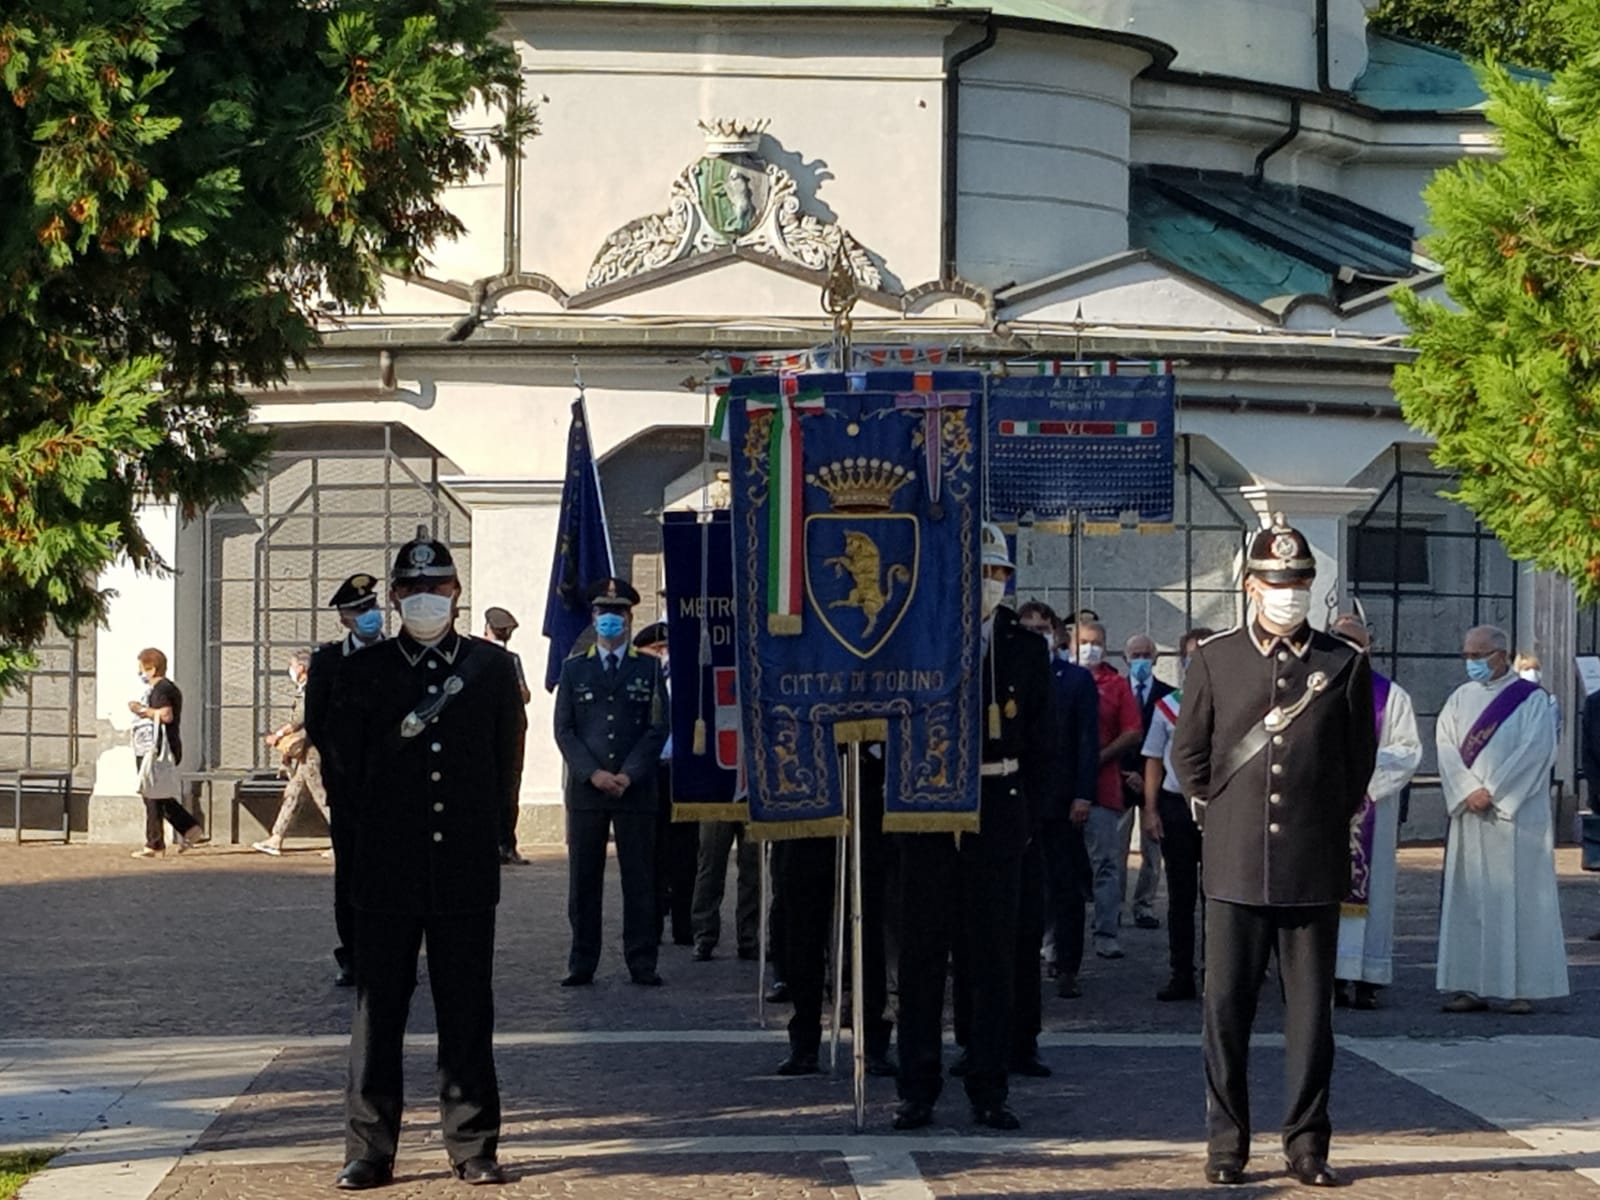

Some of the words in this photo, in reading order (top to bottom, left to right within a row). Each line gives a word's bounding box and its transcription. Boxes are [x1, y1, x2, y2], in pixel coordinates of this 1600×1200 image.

[713, 625, 731, 645] DI
[851, 671, 865, 692] DI
[872, 669, 944, 692] TORINO
